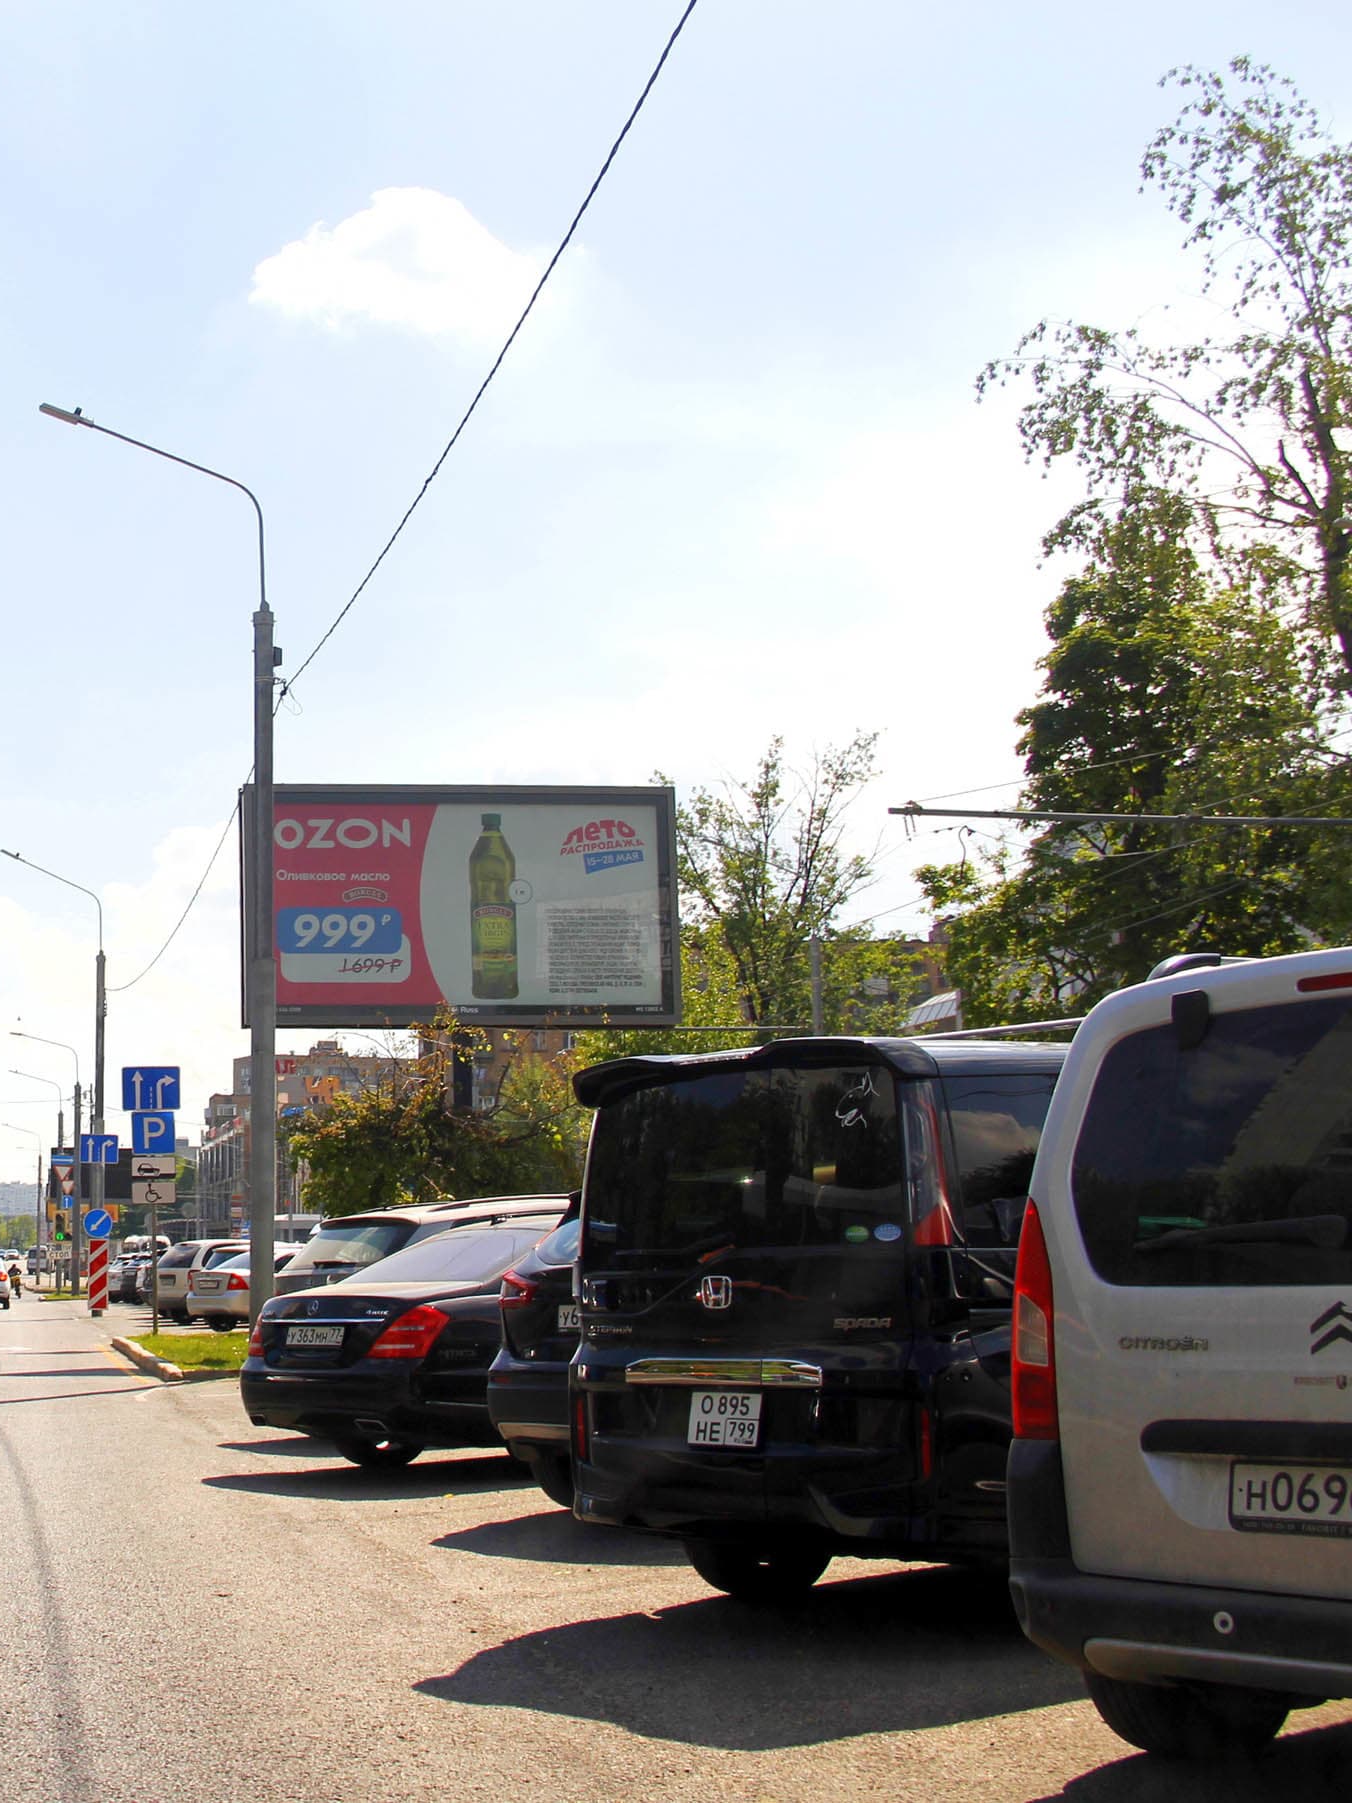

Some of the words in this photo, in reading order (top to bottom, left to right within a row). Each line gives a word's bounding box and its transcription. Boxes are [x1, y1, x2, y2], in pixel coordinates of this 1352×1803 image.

[273, 818, 411, 849] OZON
[616, 852, 640, 863] МАЯ
[276, 869, 346, 881] Оливковое
[350, 873, 390, 881] масло
[294, 914, 376, 947] 999
[142, 1117, 166, 1149] P
[729, 1422, 755, 1439] 799
[1246, 1471, 1352, 1515] Н069
